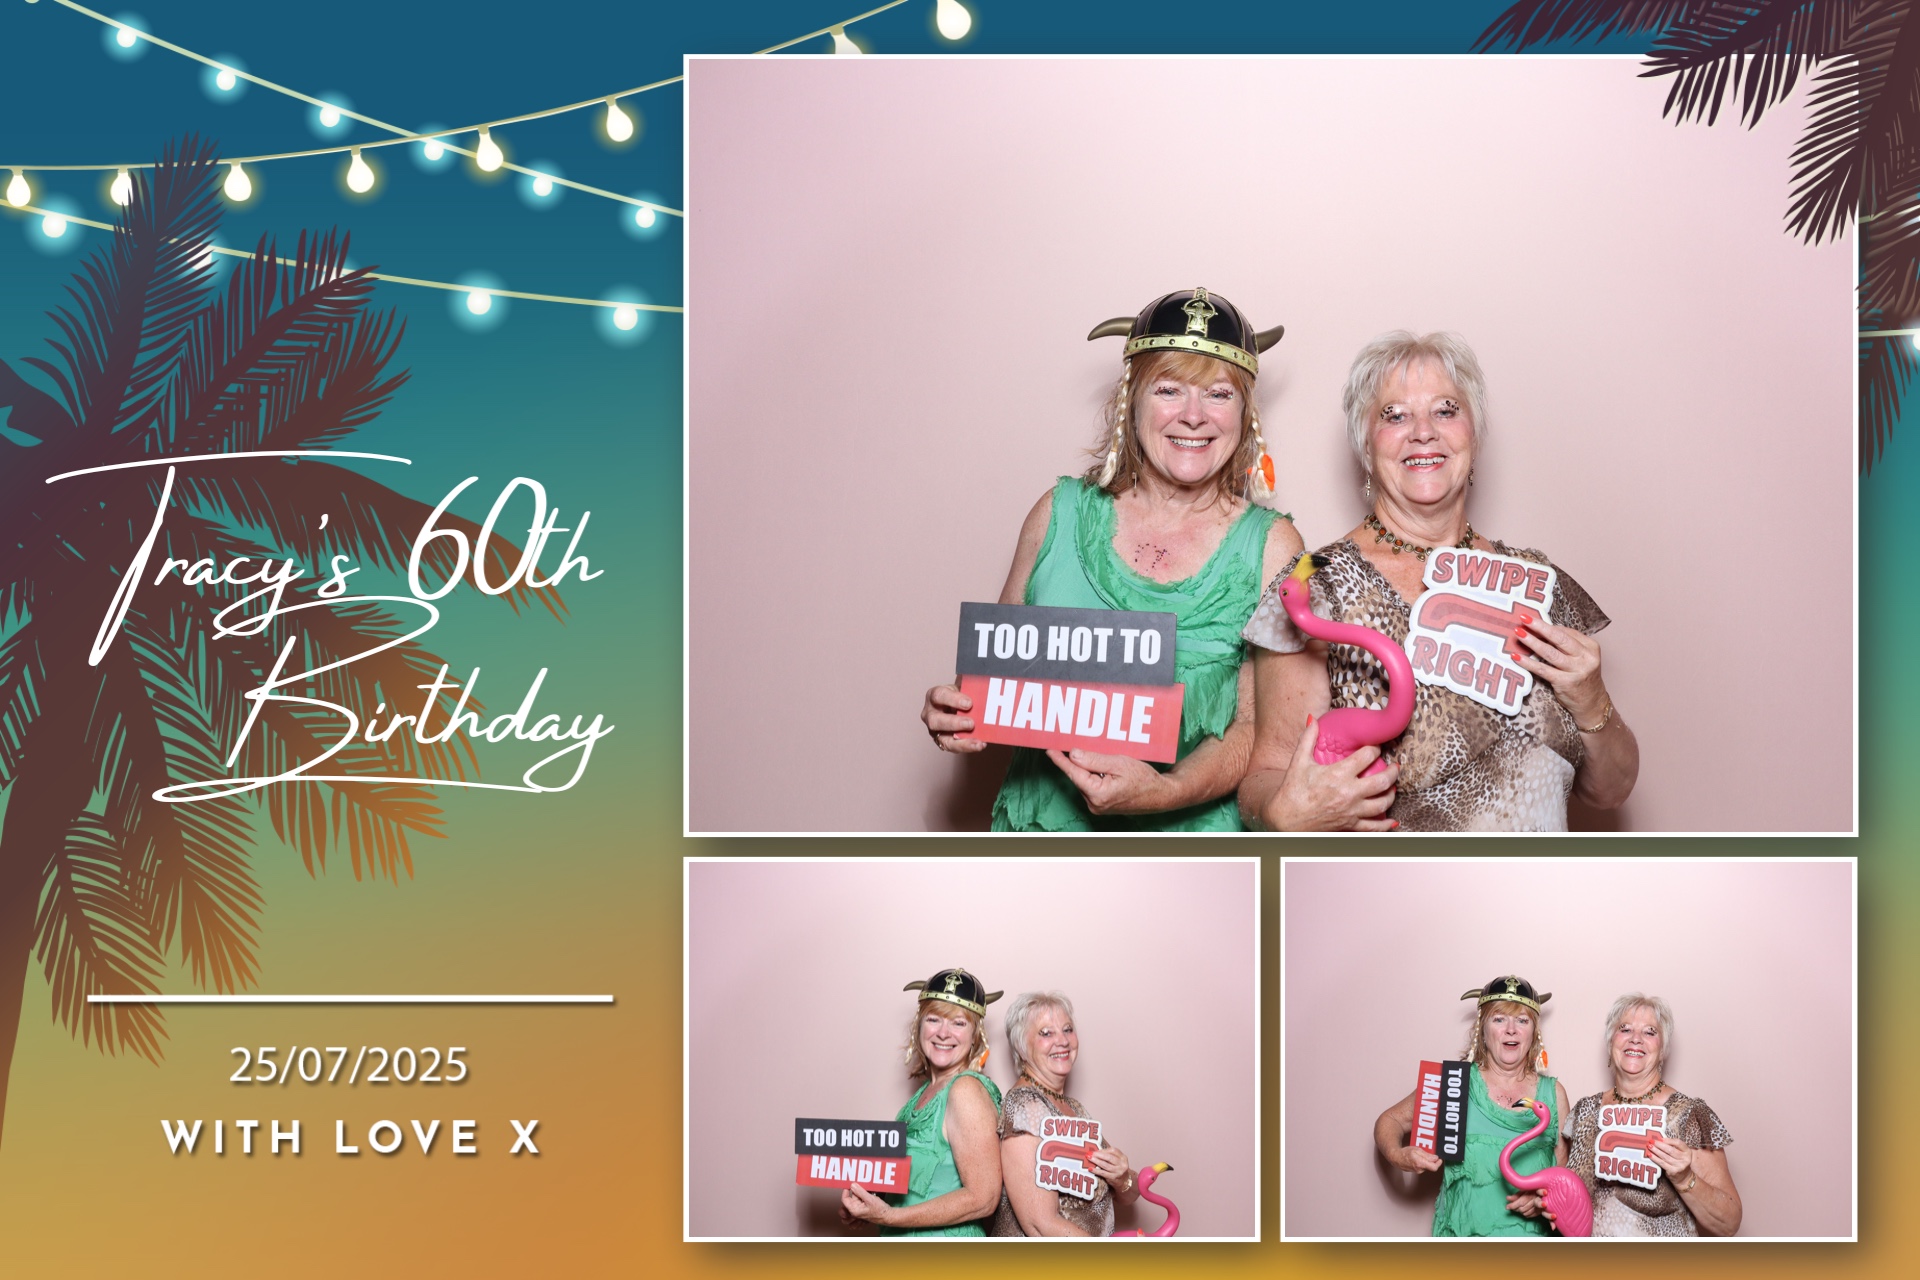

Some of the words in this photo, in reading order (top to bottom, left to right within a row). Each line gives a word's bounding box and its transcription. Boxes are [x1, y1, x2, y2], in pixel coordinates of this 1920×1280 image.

[1432, 552, 1548, 603] SWIPE
[974, 622, 1039, 660] TOO
[1047, 626, 1113, 663] HOT
[1120, 629, 1162, 665] TO
[1412, 635, 1525, 707] RIGHT
[983, 677, 1155, 744] HANDLE
[1447, 1068, 1462, 1098] TOO
[1415, 1073, 1442, 1150] HANDLE
[1445, 1101, 1460, 1132] HOT
[1602, 1107, 1663, 1128] SWIPE
[803, 1128, 837, 1147] TOO
[841, 1129, 875, 1147] HOT
[878, 1129, 900, 1148] TO
[1043, 1118, 1099, 1140] SWIPE
[1443, 1135, 1458, 1155] TO
[810, 1155, 897, 1186] HANDLE
[1039, 1164, 1094, 1195] RIGHT
[1599, 1155, 1657, 1185] RIGHT
